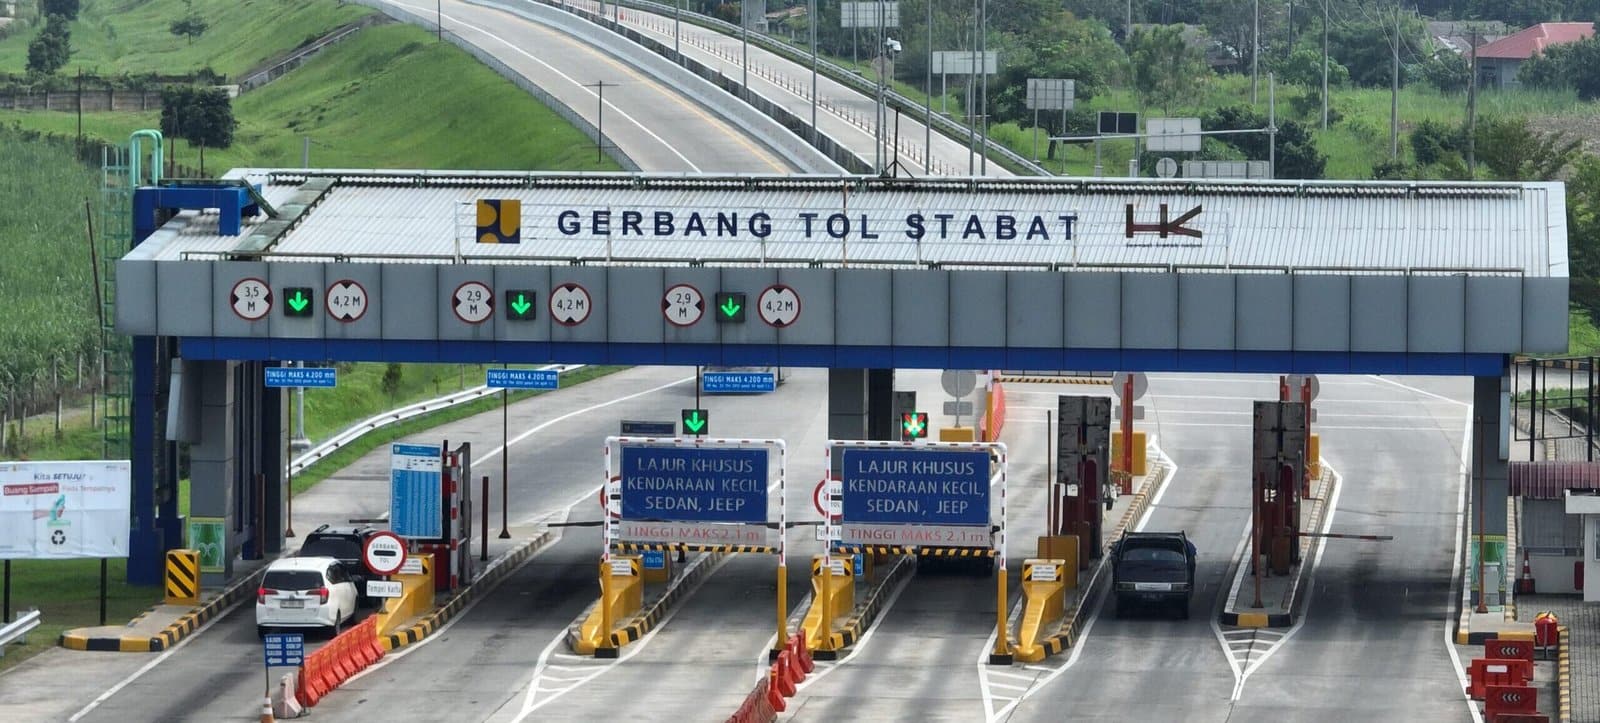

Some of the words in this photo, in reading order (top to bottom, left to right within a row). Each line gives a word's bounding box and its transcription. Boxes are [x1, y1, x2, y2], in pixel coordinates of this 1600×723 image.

[558, 209, 772, 238] GERBANG
[799, 212, 878, 240] TOL
[905, 213, 1077, 241] STABAT
[245, 286, 259, 298] 3,5
[467, 291, 481, 303] 2,9
[333, 296, 349, 308] 4,2
[352, 296, 360, 306] M
[676, 293, 691, 305] 2,9
[247, 301, 256, 311] M
[470, 305, 478, 314] M
[556, 300, 573, 311] 4,2
[576, 300, 584, 310] M
[766, 301, 783, 312] 4,2
[785, 301, 793, 311] M
[679, 307, 687, 318] M
[288, 371, 304, 379] MAKS
[488, 372, 508, 380] TINGGI
[510, 372, 526, 380] MAKS
[704, 375, 724, 383] TINGGI
[638, 457, 686, 472] LAJUR
[691, 459, 753, 473] KHUSUS
[858, 460, 908, 474] LAJUR
[912, 461, 975, 476] KHUSUS
[627, 476, 715, 491] KENDARAAN
[722, 478, 764, 495] KECIL,
[849, 479, 937, 494] KENDARAAN
[942, 481, 985, 498] KECIL,
[645, 495, 702, 513] SEDAN,
[707, 498, 745, 512] JEEP
[936, 500, 969, 514] JEEP
[746, 531, 760, 540] m
[849, 528, 897, 540] TINGGI
[901, 529, 942, 541] MAKS
[946, 531, 966, 542] 2.1
[970, 533, 984, 542] m
